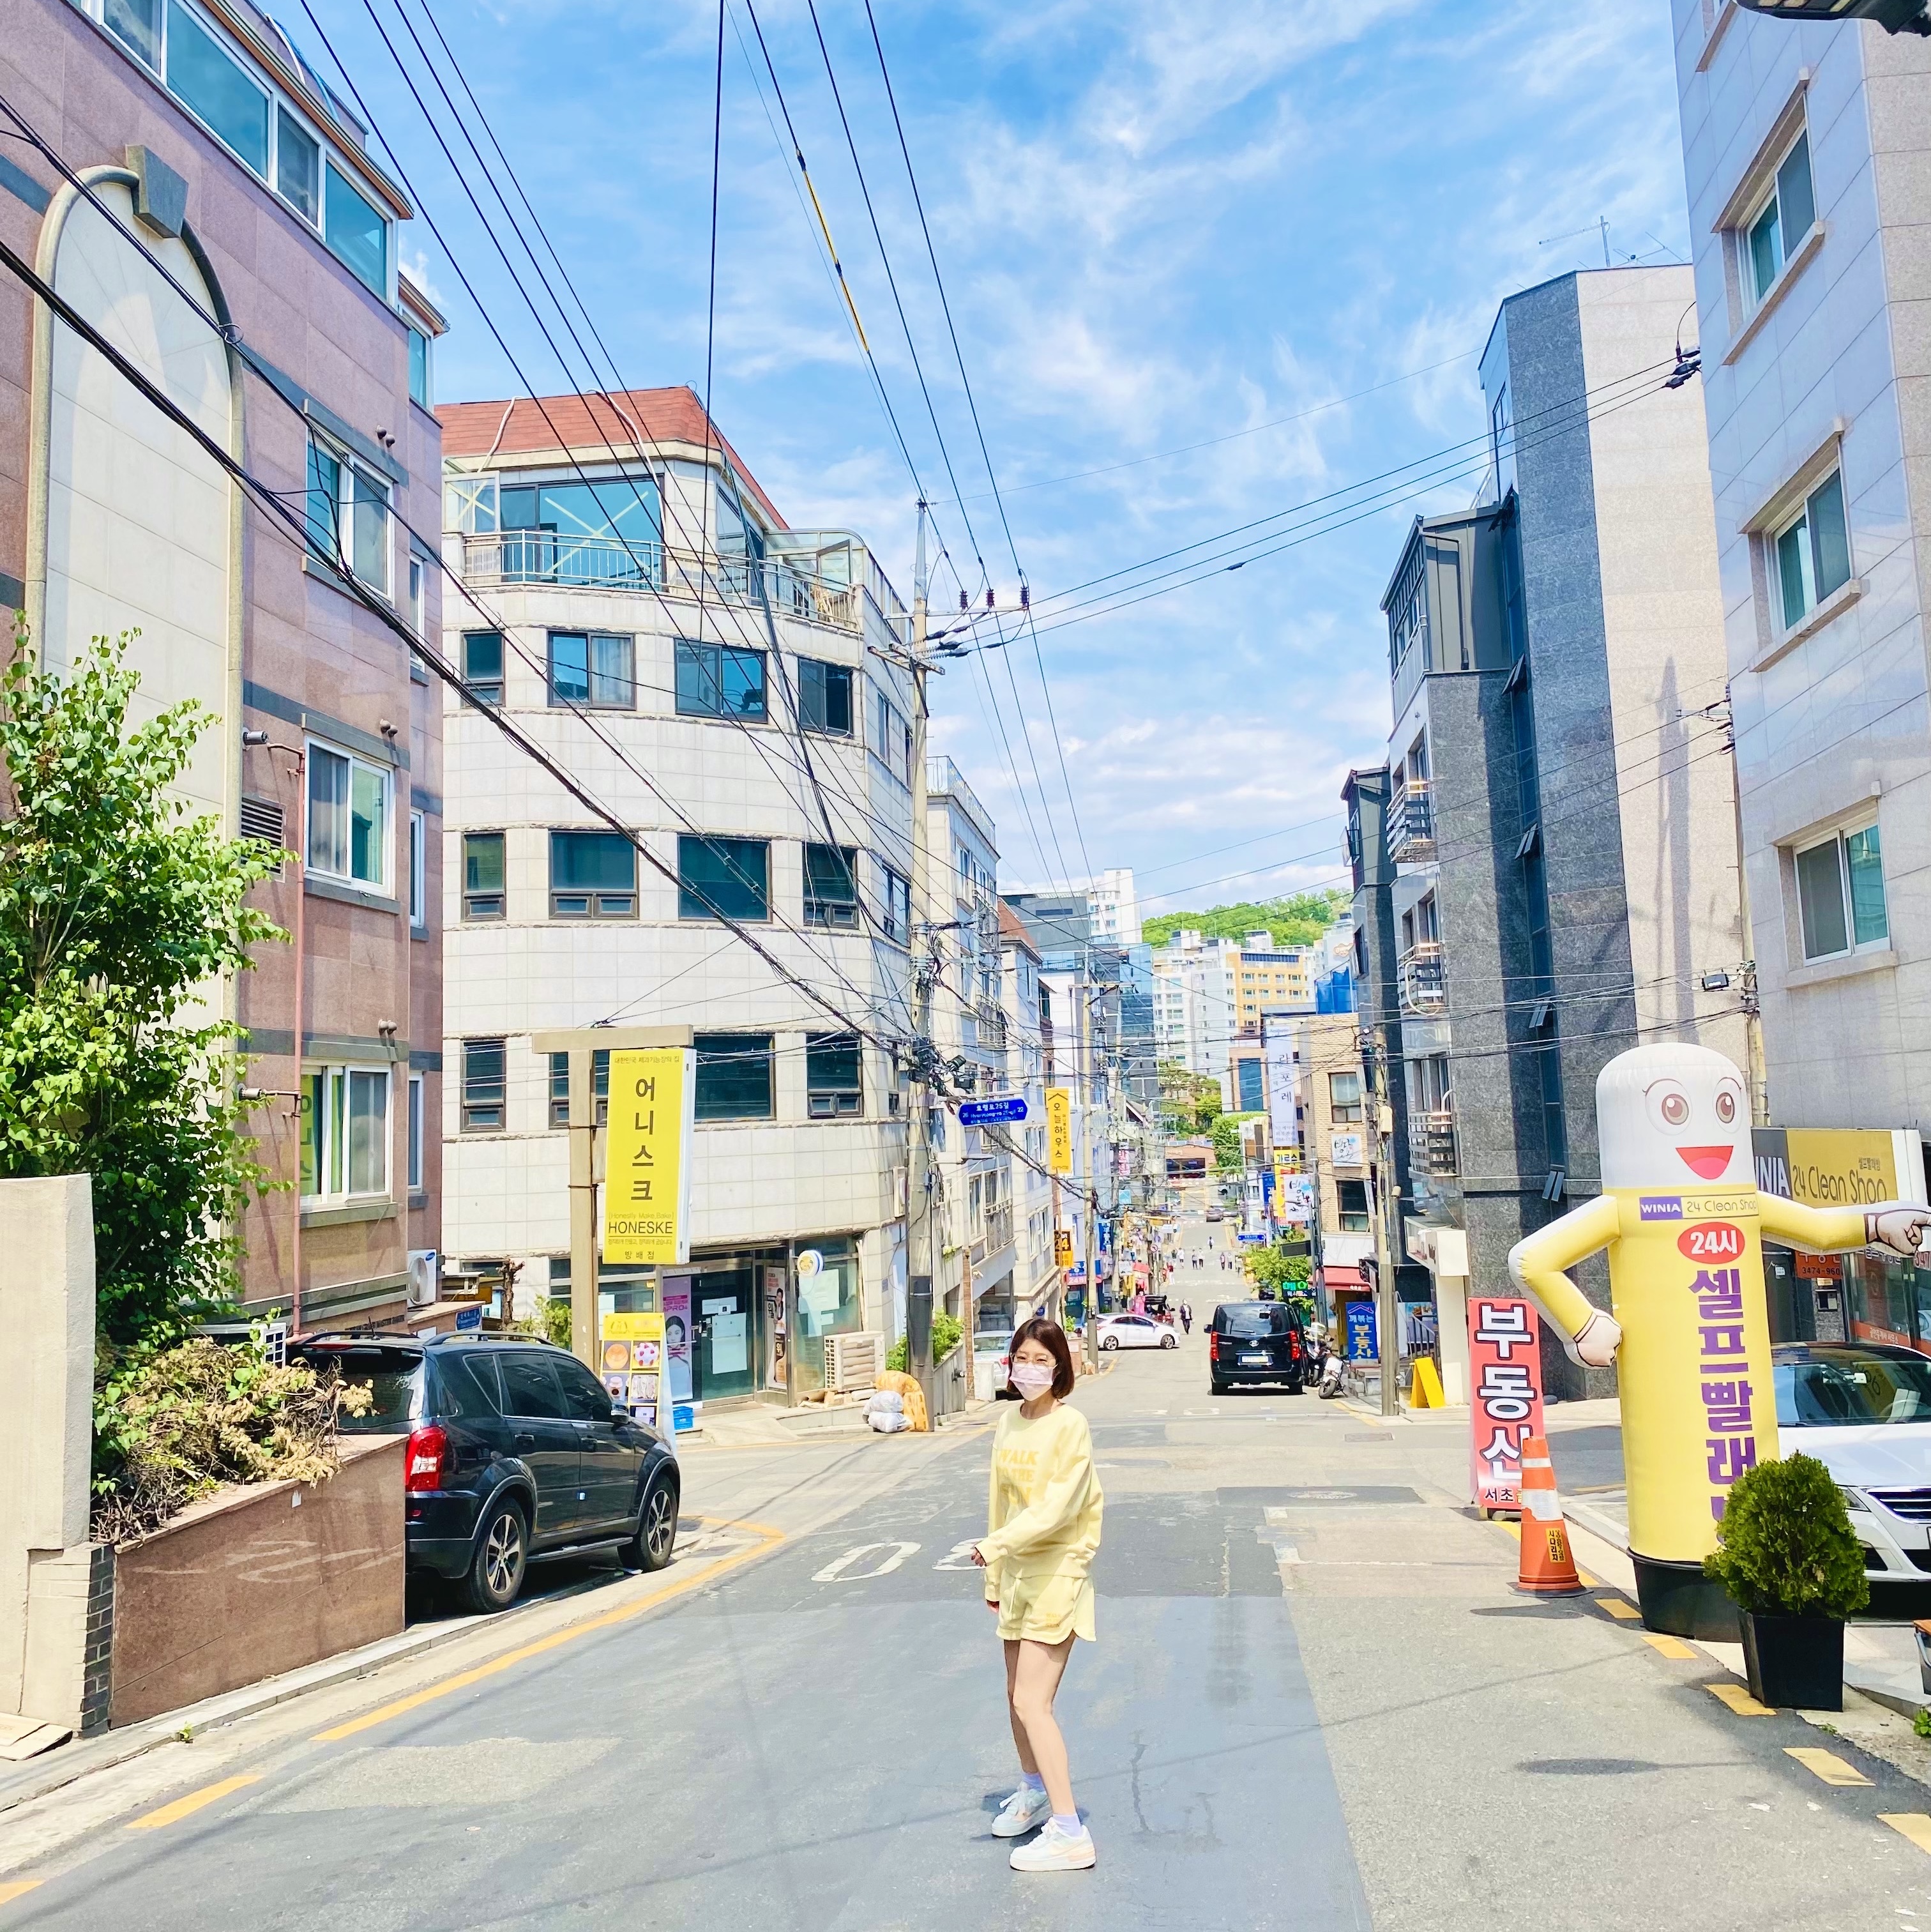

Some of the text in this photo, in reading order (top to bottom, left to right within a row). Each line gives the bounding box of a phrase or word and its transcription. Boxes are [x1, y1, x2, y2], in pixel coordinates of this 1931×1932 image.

[631, 1077, 655, 1200] 어니스크
[1054, 1102, 1063, 1158] 오늘하우스
[1755, 1156, 1887, 1204] INIA 24 Clean Shop
[1640, 1199, 1757, 1213] WINIA 24 Clean Shop
[608, 1221, 673, 1234] HONESKE
[1690, 1229, 1738, 1255] 24시
[1802, 1266, 1843, 1275] 3474-960
[1349, 1315, 1374, 1323] 깨볶는
[1352, 1325, 1374, 1359] 부동산
[1474, 1303, 1537, 1480] 부동산
[998, 1449, 1039, 1465] WALK
[1485, 1487, 1522, 1505] 서초
